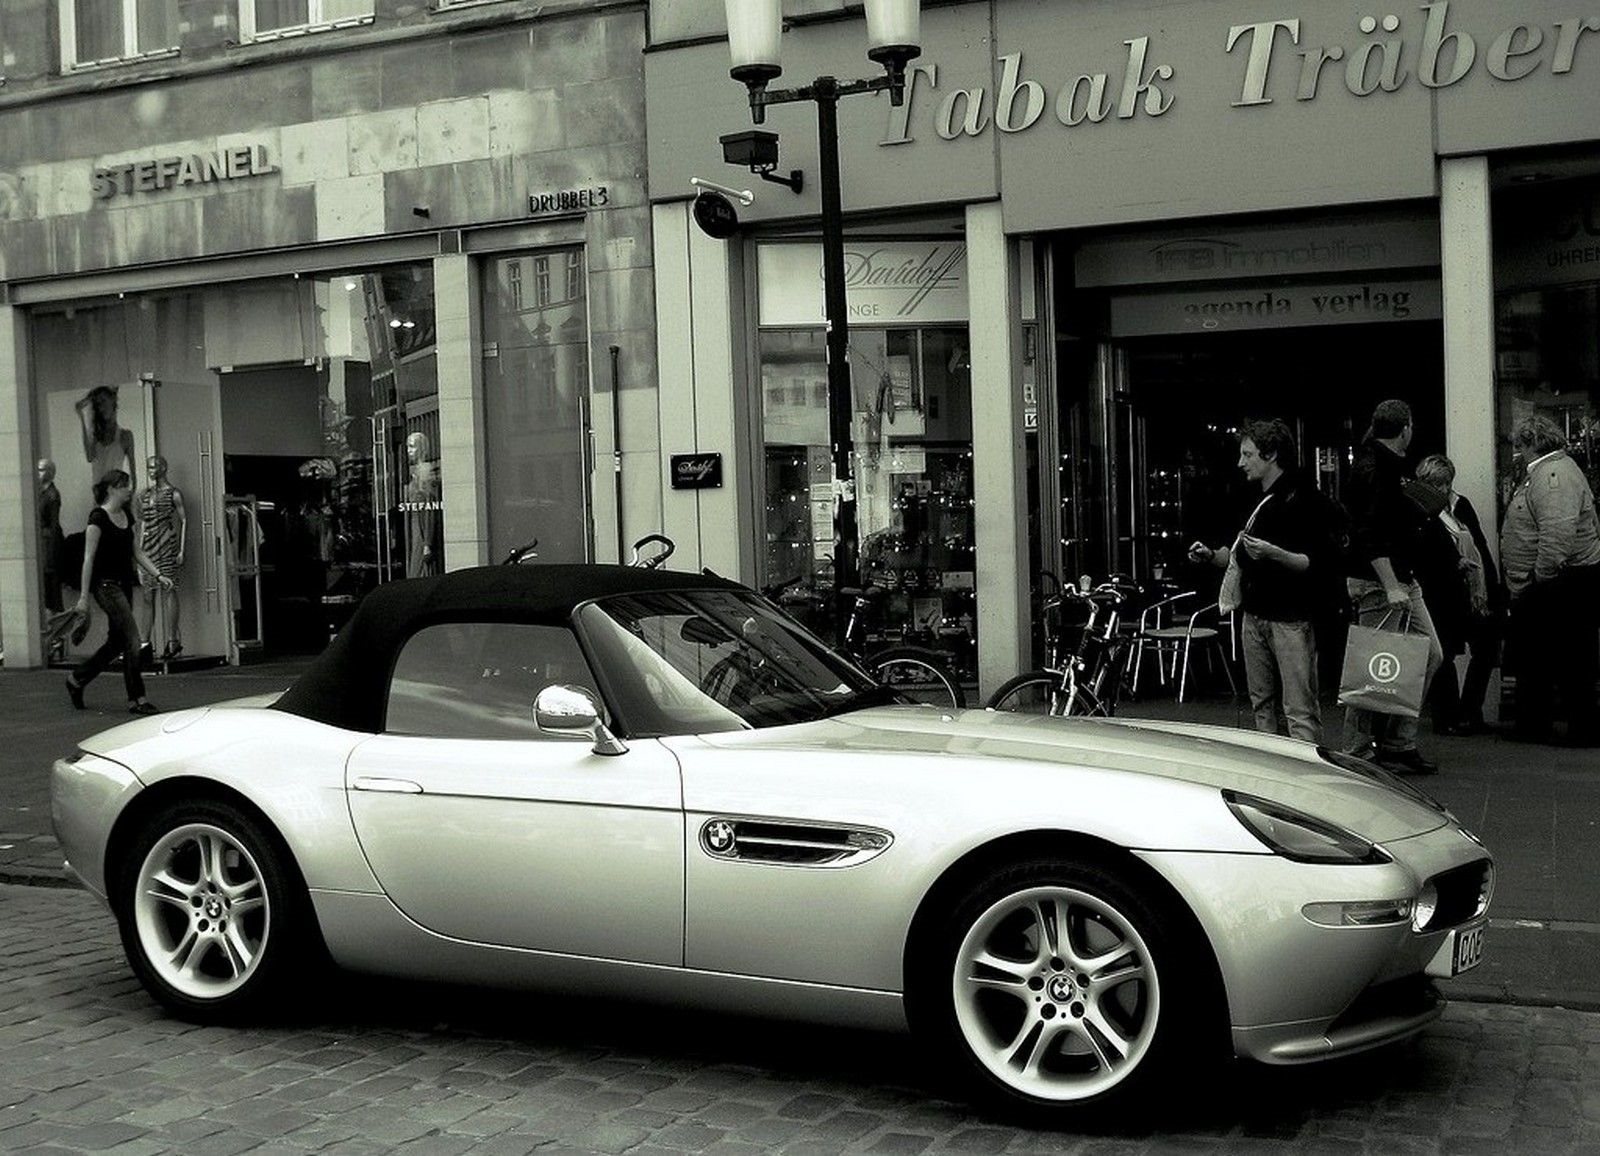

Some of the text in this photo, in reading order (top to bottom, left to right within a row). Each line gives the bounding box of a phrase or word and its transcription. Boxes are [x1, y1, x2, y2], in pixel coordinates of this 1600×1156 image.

[879, 0, 1600, 147] Tabak Träber
[92, 144, 280, 200] STEFANEL
[1312, 287, 1410, 318] verlag
